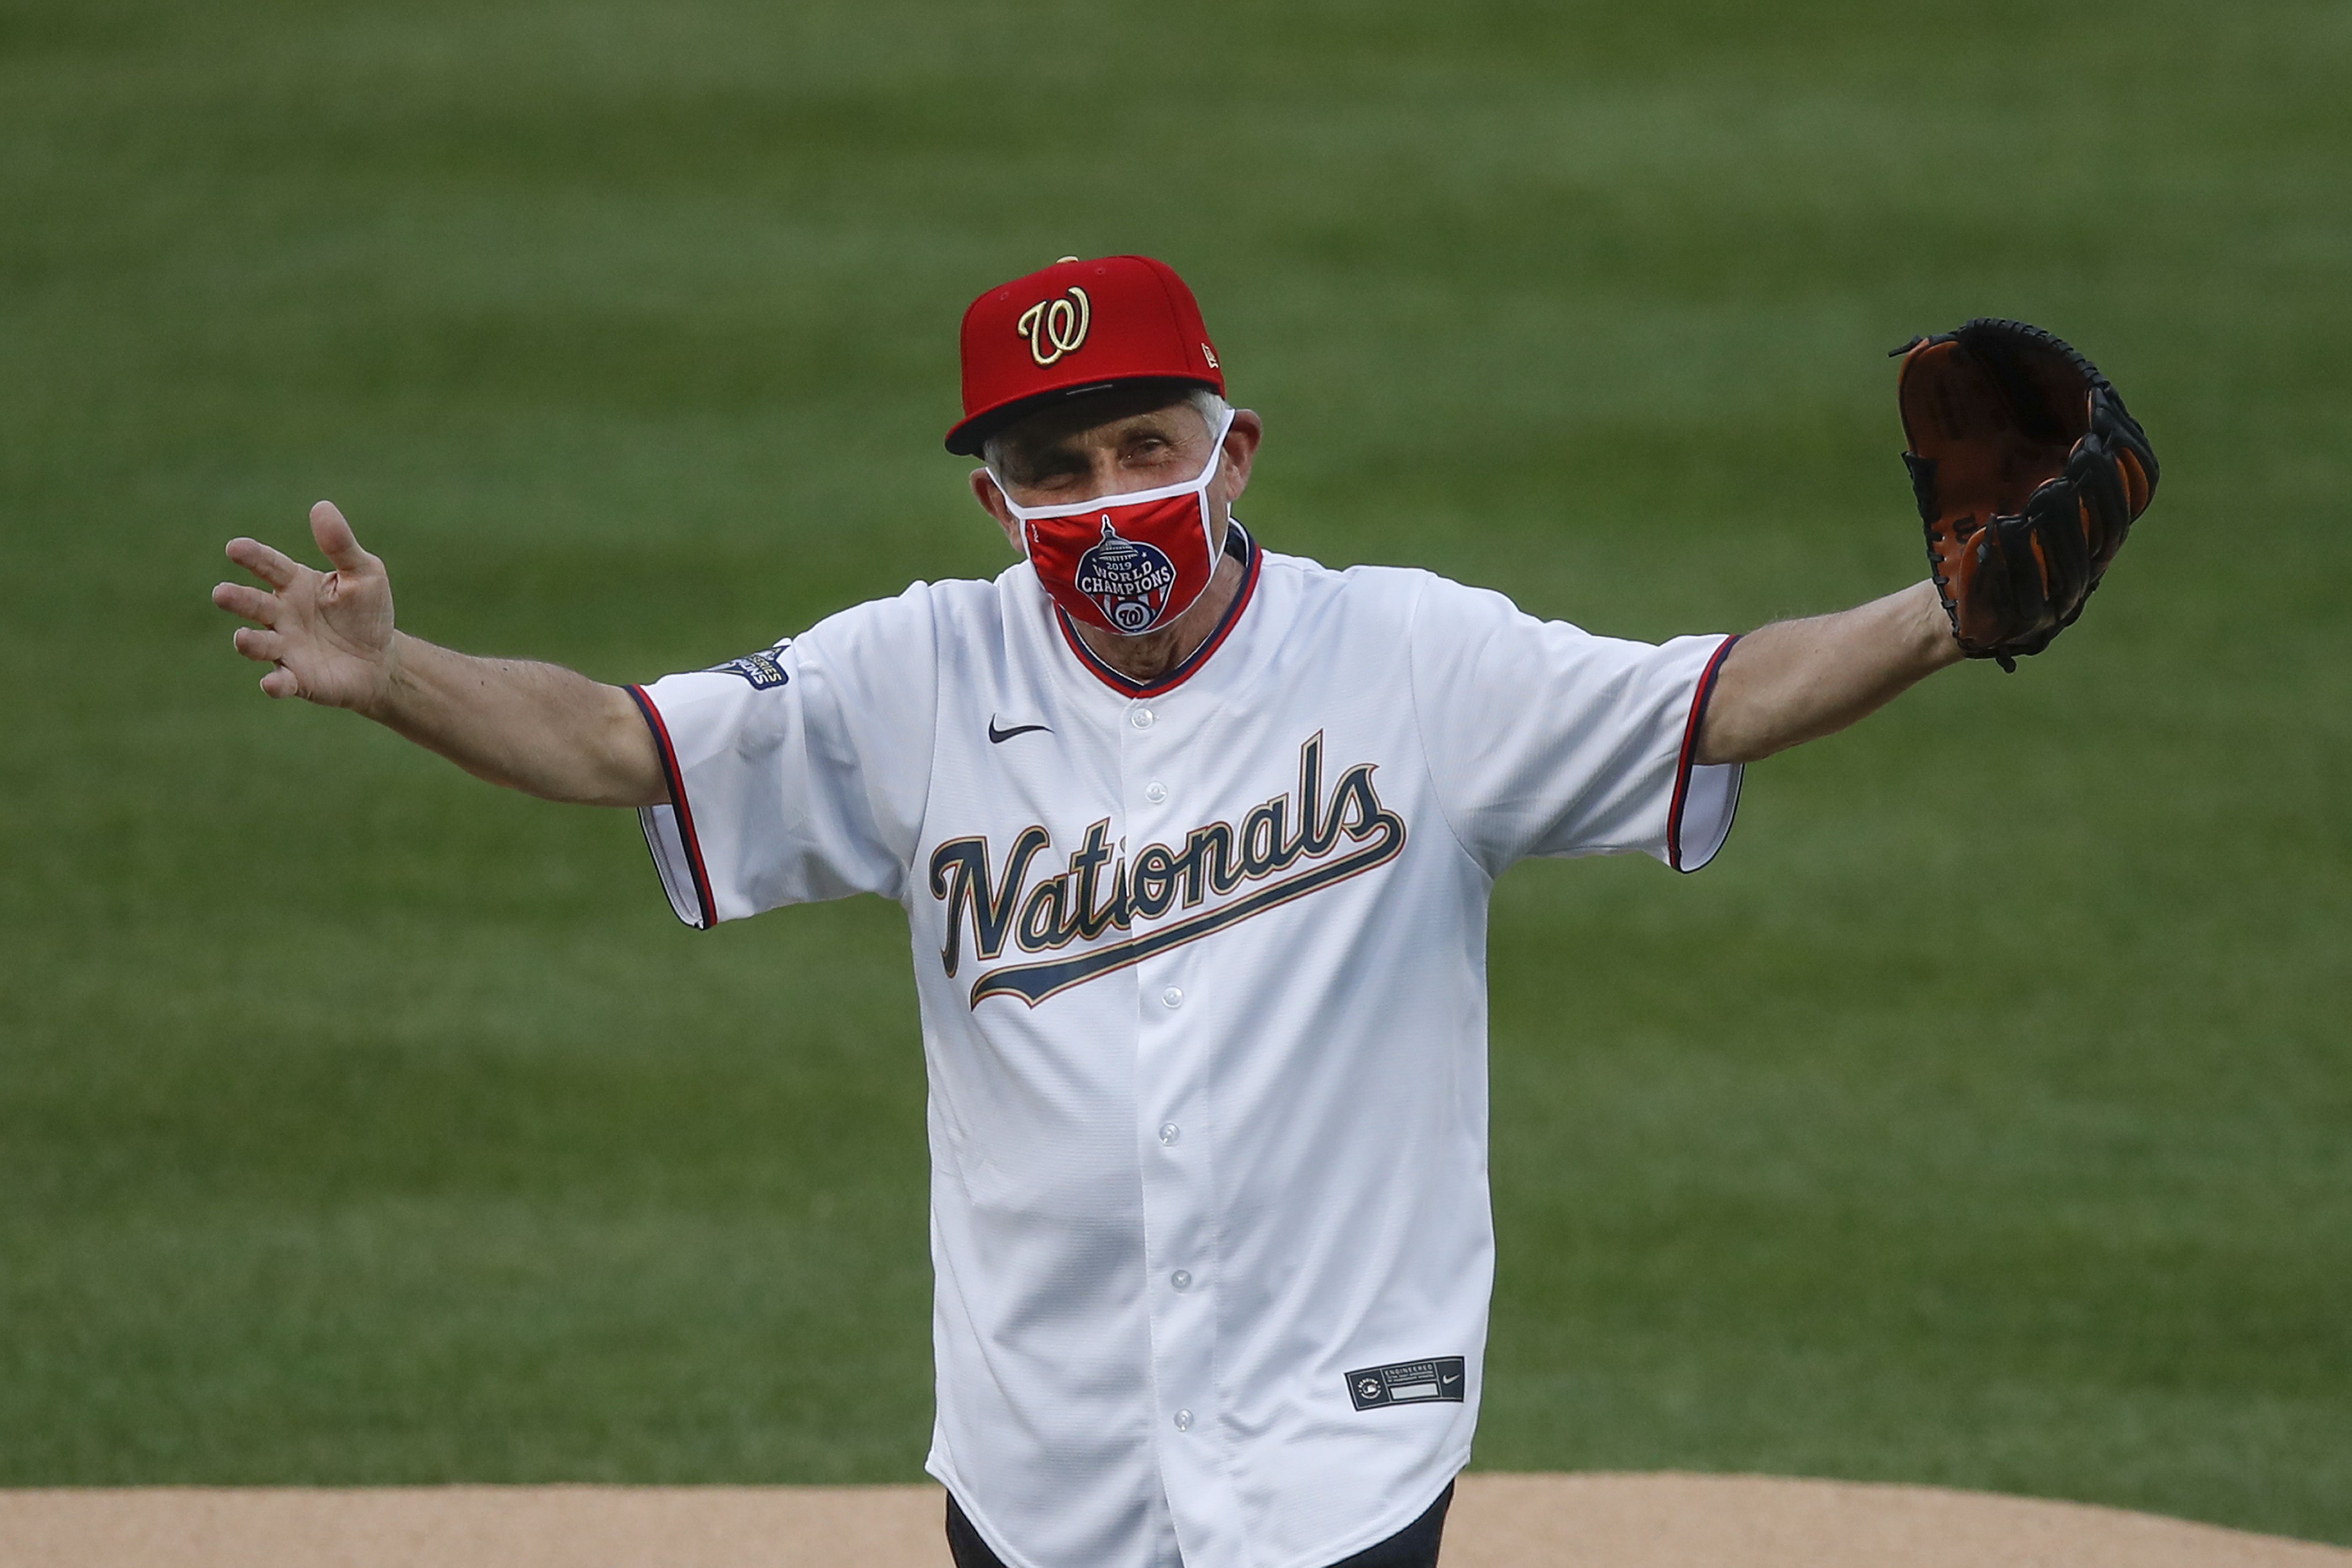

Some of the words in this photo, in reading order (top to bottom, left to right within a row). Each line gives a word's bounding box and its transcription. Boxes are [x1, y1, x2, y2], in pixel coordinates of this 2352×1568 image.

[1017, 285, 1091, 368] W
[1081, 566, 1171, 595] CHAMPIONS
[1092, 560, 1152, 582] WORLD
[1106, 562, 1132, 572] 2019
[929, 728, 1406, 980] Nationals
